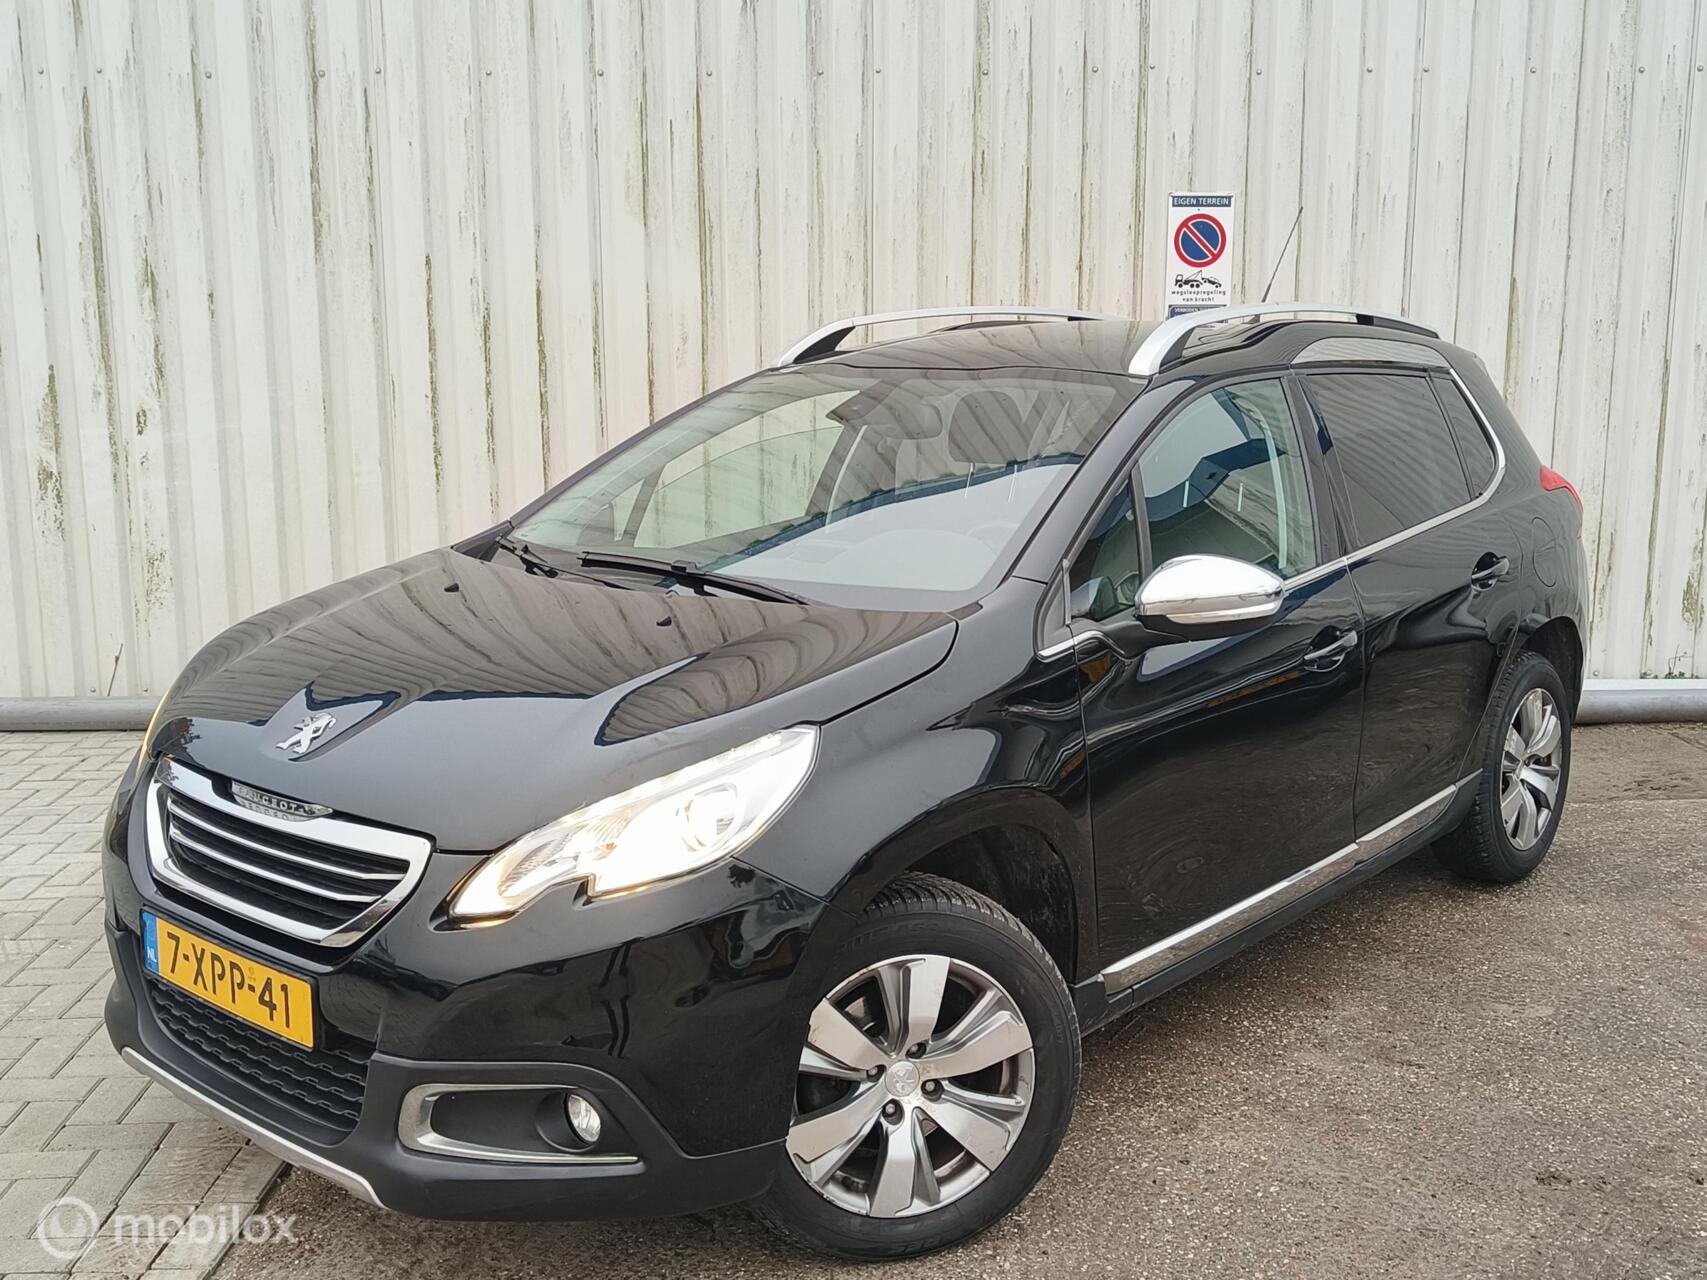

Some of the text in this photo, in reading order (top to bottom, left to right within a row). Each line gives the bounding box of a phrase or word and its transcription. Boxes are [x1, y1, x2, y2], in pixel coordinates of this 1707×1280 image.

[1174, 197, 1229, 205] EIGEN TERREIN
[146, 945, 157, 963] NL
[167, 931, 290, 1029] 7-XPP-41
